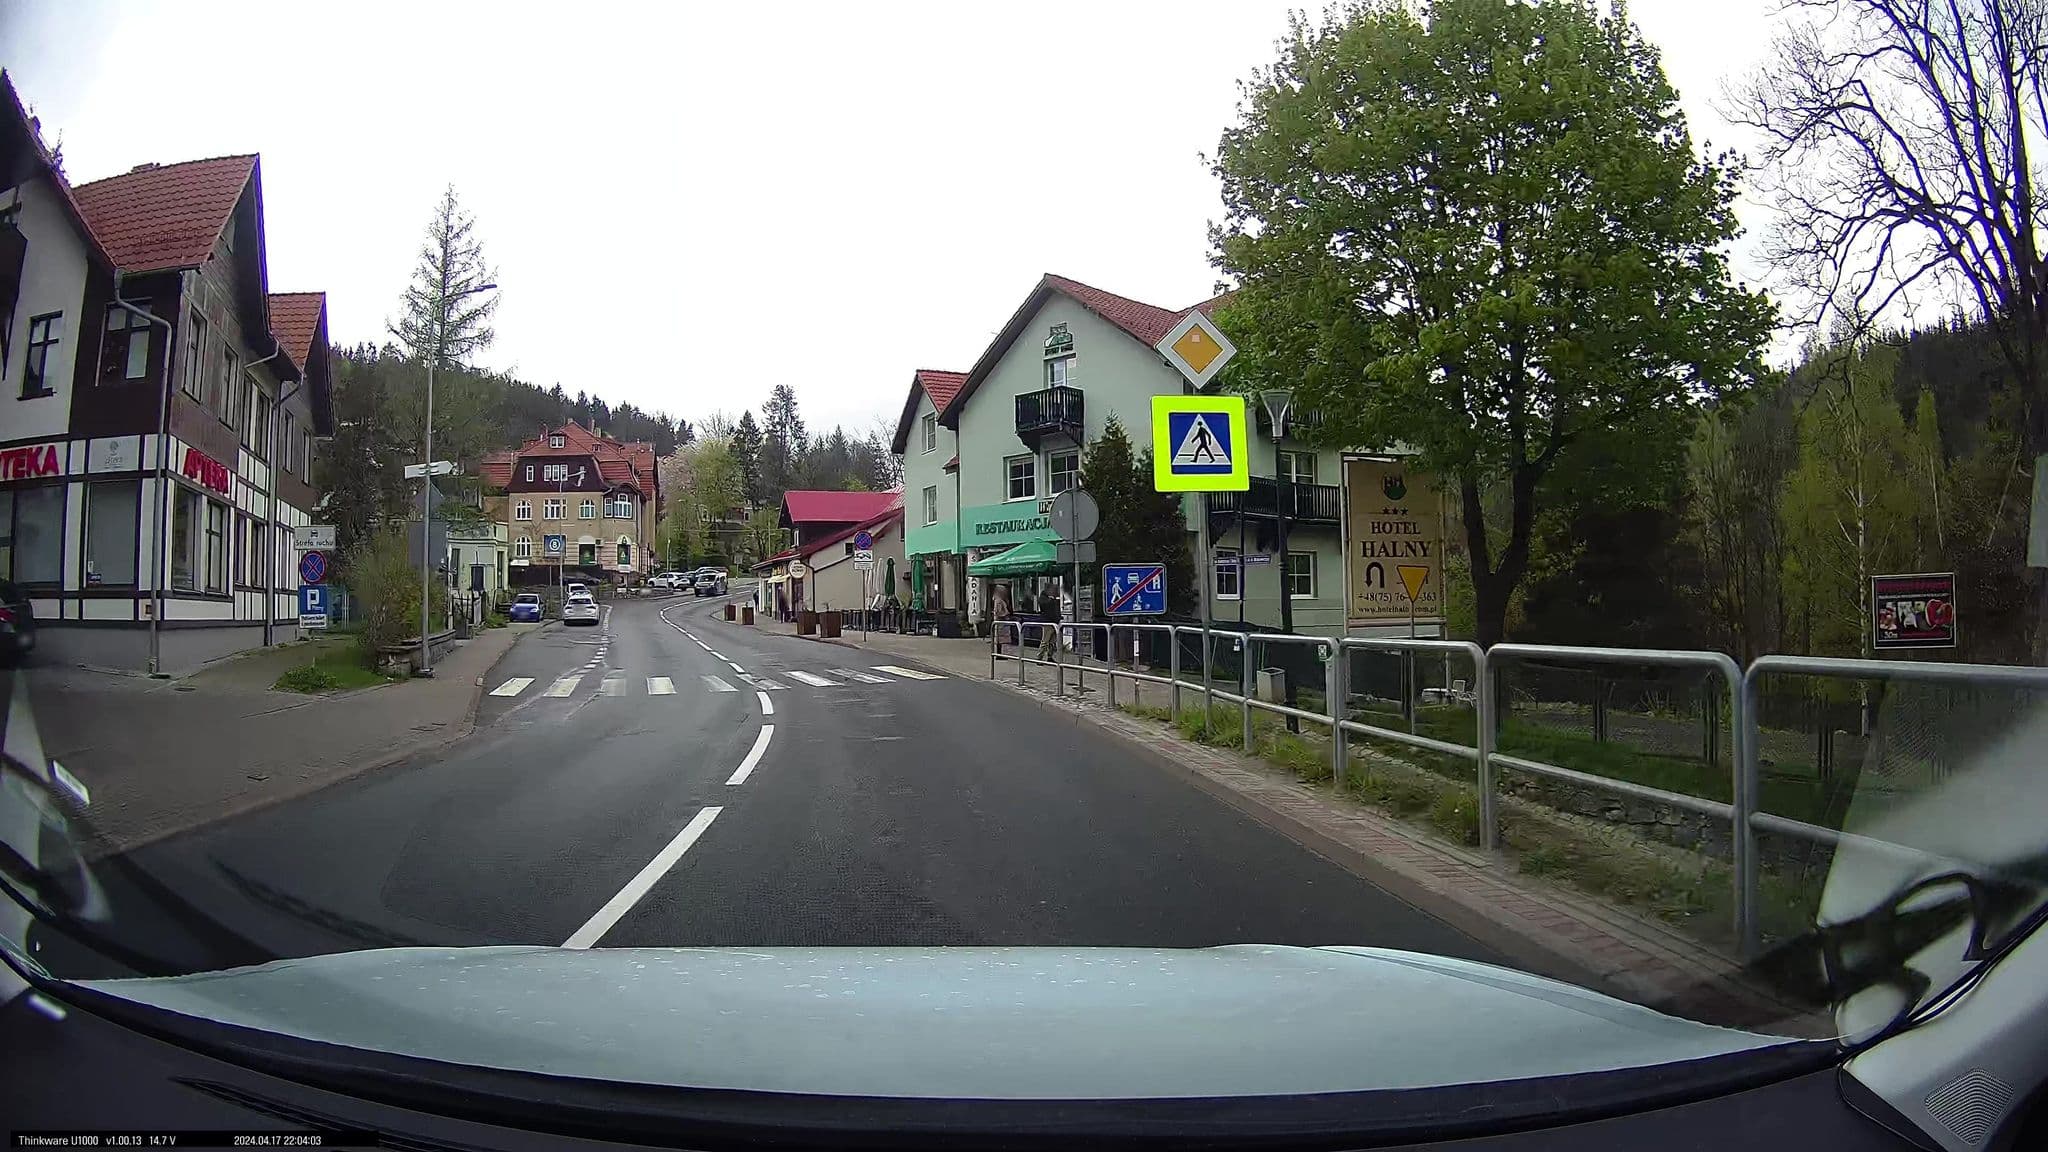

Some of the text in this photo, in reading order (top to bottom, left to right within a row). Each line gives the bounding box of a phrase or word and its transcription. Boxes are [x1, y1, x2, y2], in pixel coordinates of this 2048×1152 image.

[1370, 521, 1421, 535] HOTEL
[1361, 540, 1432, 557] HALNY
[306, 589, 320, 611] P
